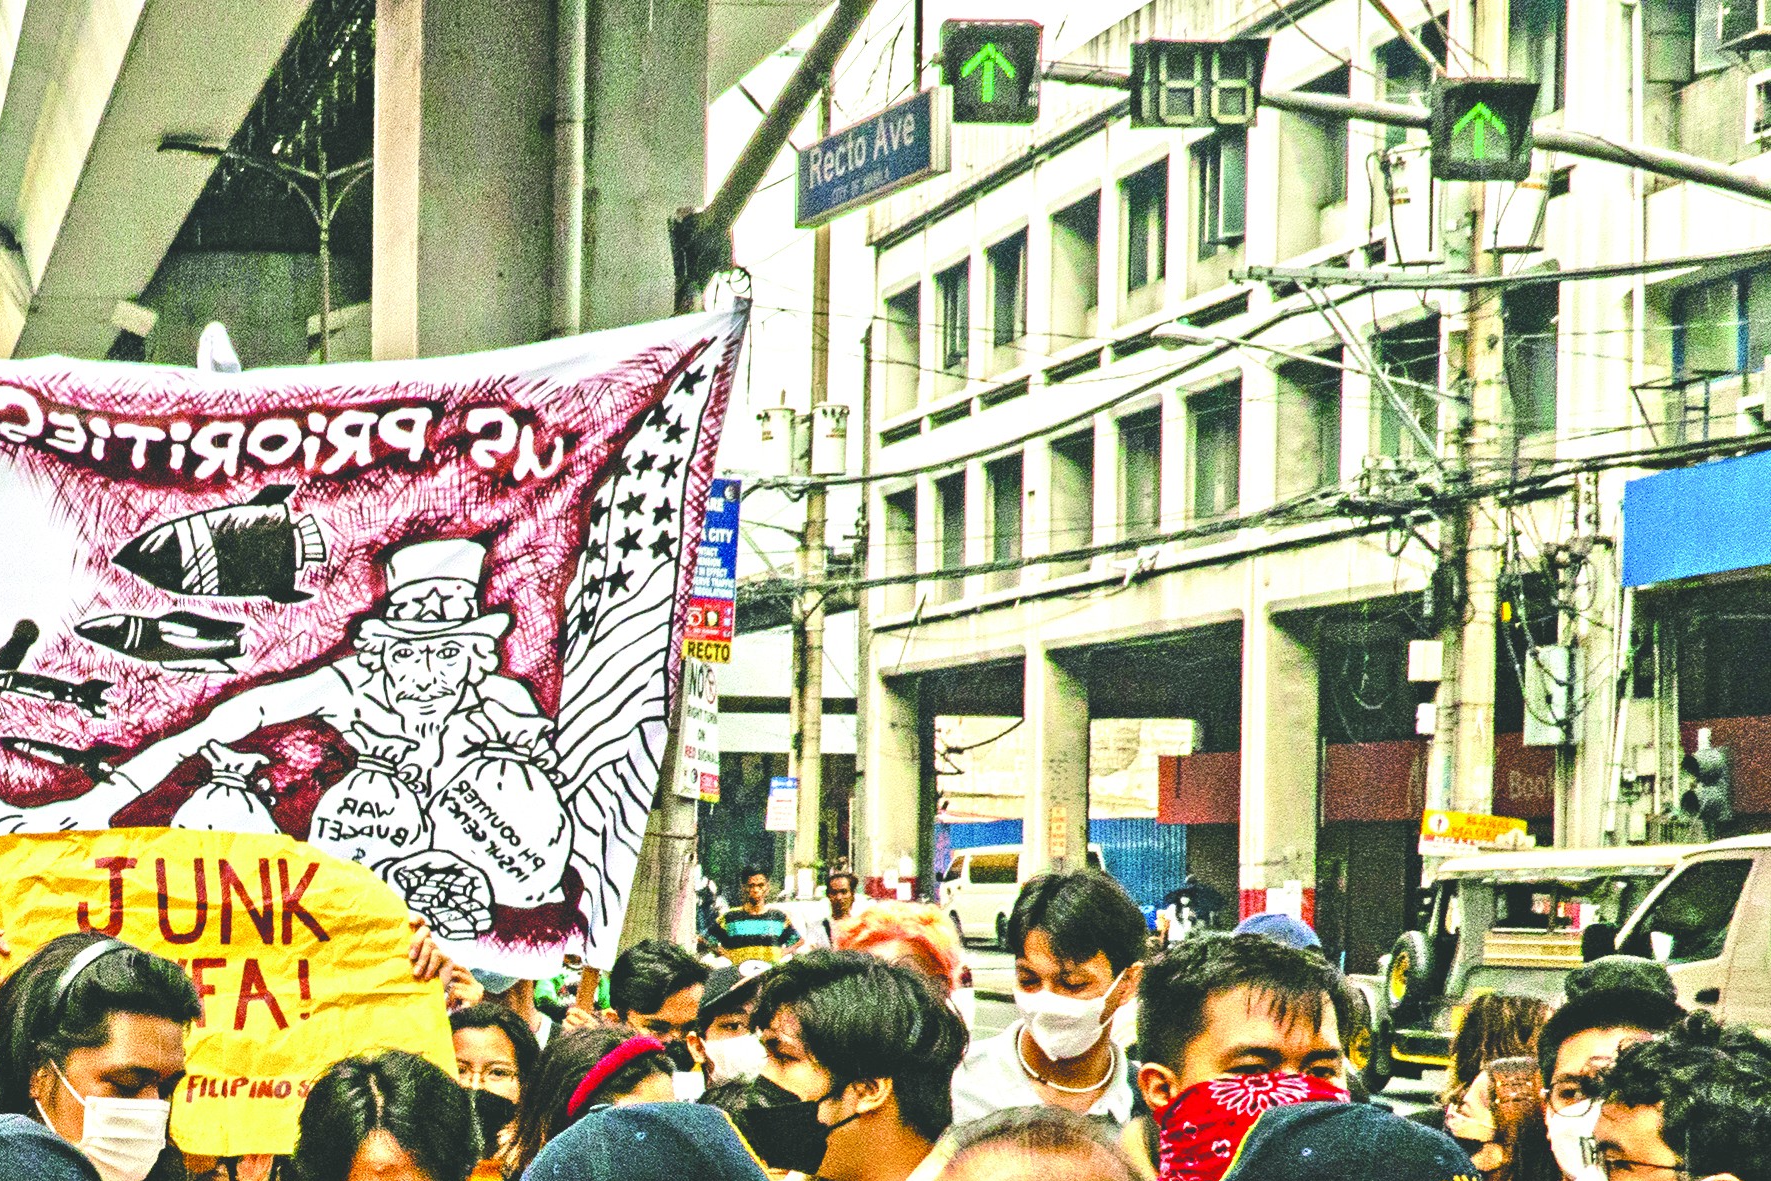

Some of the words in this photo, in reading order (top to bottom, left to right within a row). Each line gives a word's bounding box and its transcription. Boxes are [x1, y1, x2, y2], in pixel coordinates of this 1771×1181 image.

[808, 132, 866, 189] Recto
[873, 113, 916, 160] Ave
[708, 527, 734, 544] CITY
[687, 639, 731, 662] RECTO
[689, 662, 705, 699] NO
[76, 854, 332, 946] JUNK
[191, 955, 313, 1032] FA!
